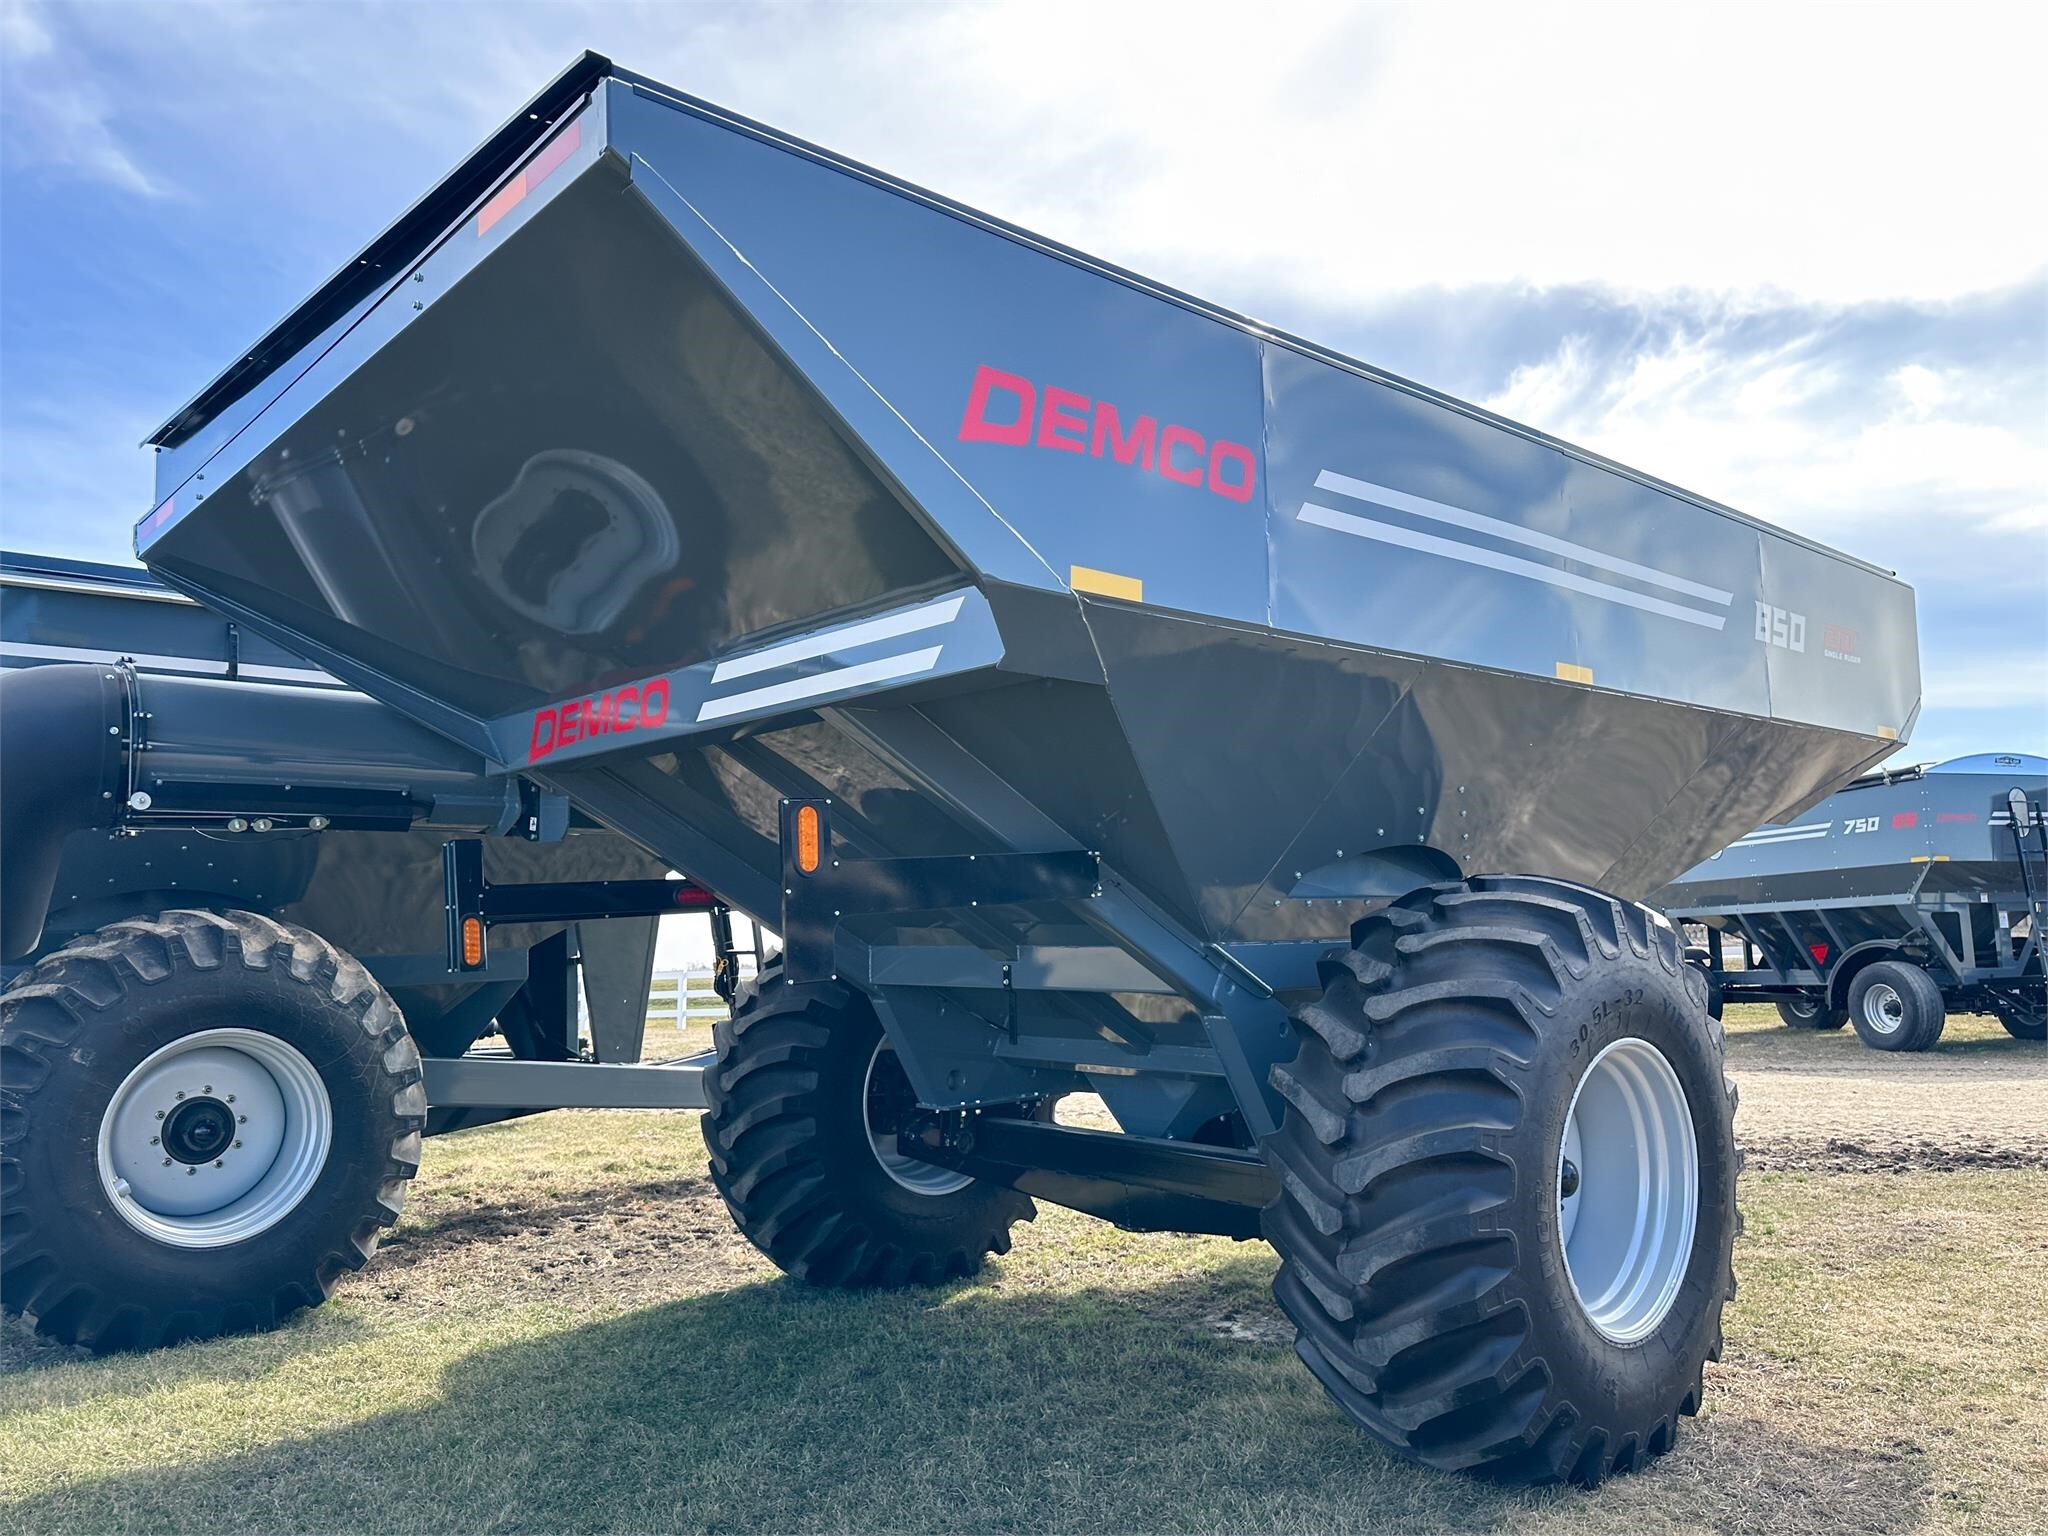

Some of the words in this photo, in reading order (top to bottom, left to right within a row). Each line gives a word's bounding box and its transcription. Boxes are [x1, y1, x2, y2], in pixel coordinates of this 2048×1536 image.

[958, 364, 1256, 504] DEMCO
[1755, 600, 1806, 653] 850
[528, 678, 671, 764] DEMCO
[1843, 816, 1880, 835] 750
